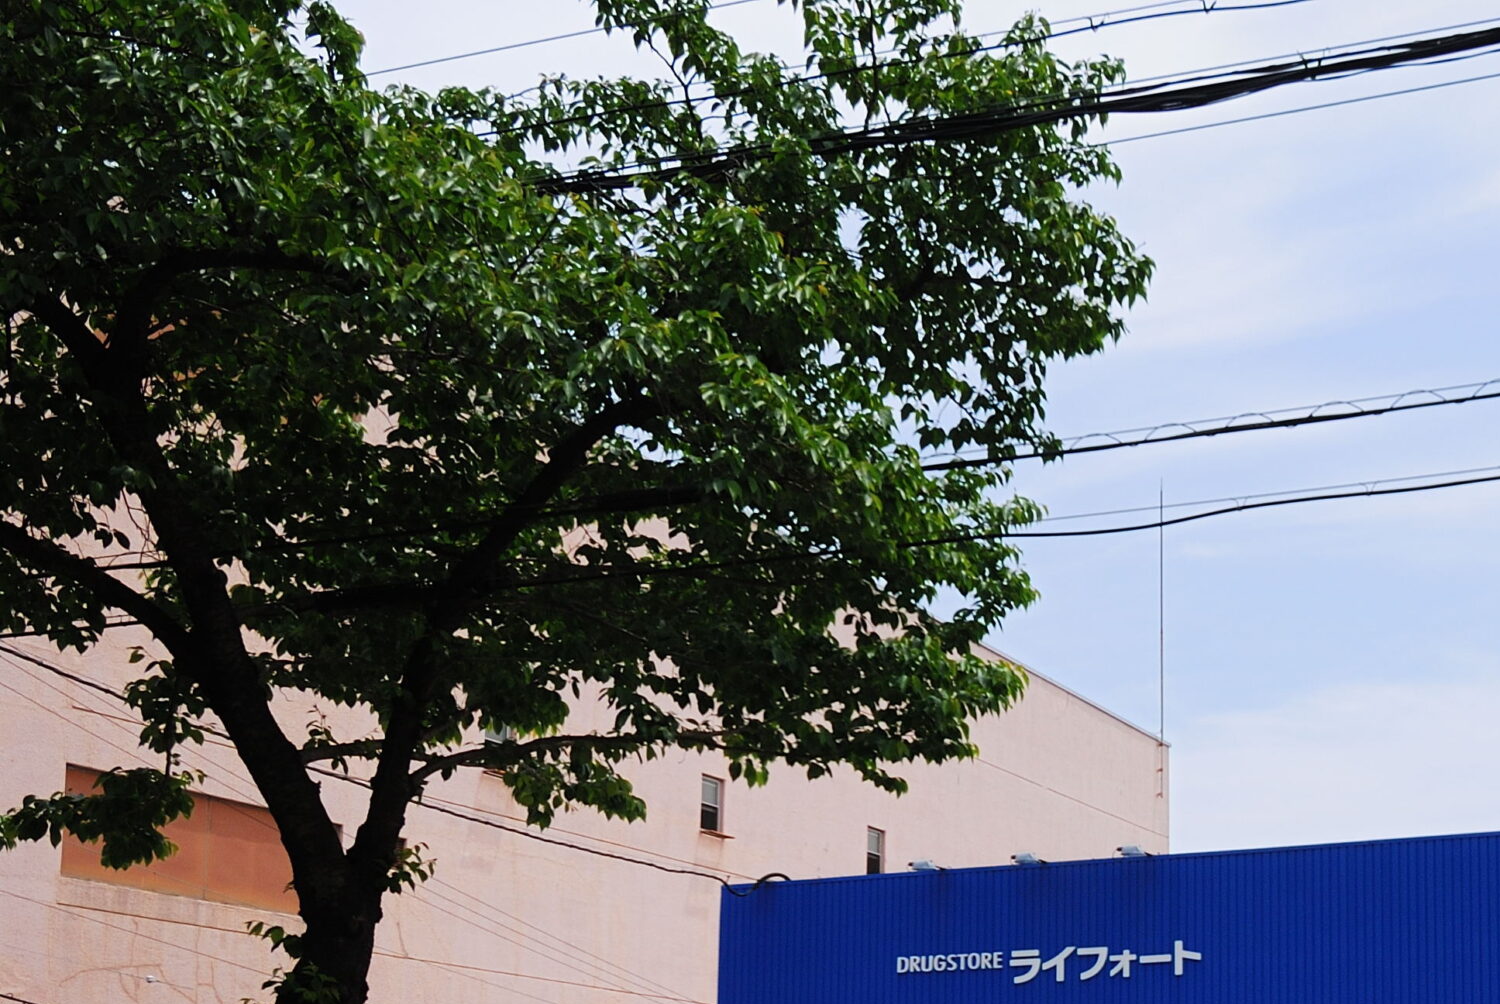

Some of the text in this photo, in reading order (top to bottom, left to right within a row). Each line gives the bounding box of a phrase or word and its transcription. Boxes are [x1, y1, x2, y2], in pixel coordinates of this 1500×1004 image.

[896, 951, 1003, 974] DRUGSTORE
[1009, 940, 1203, 984] ライフォート
